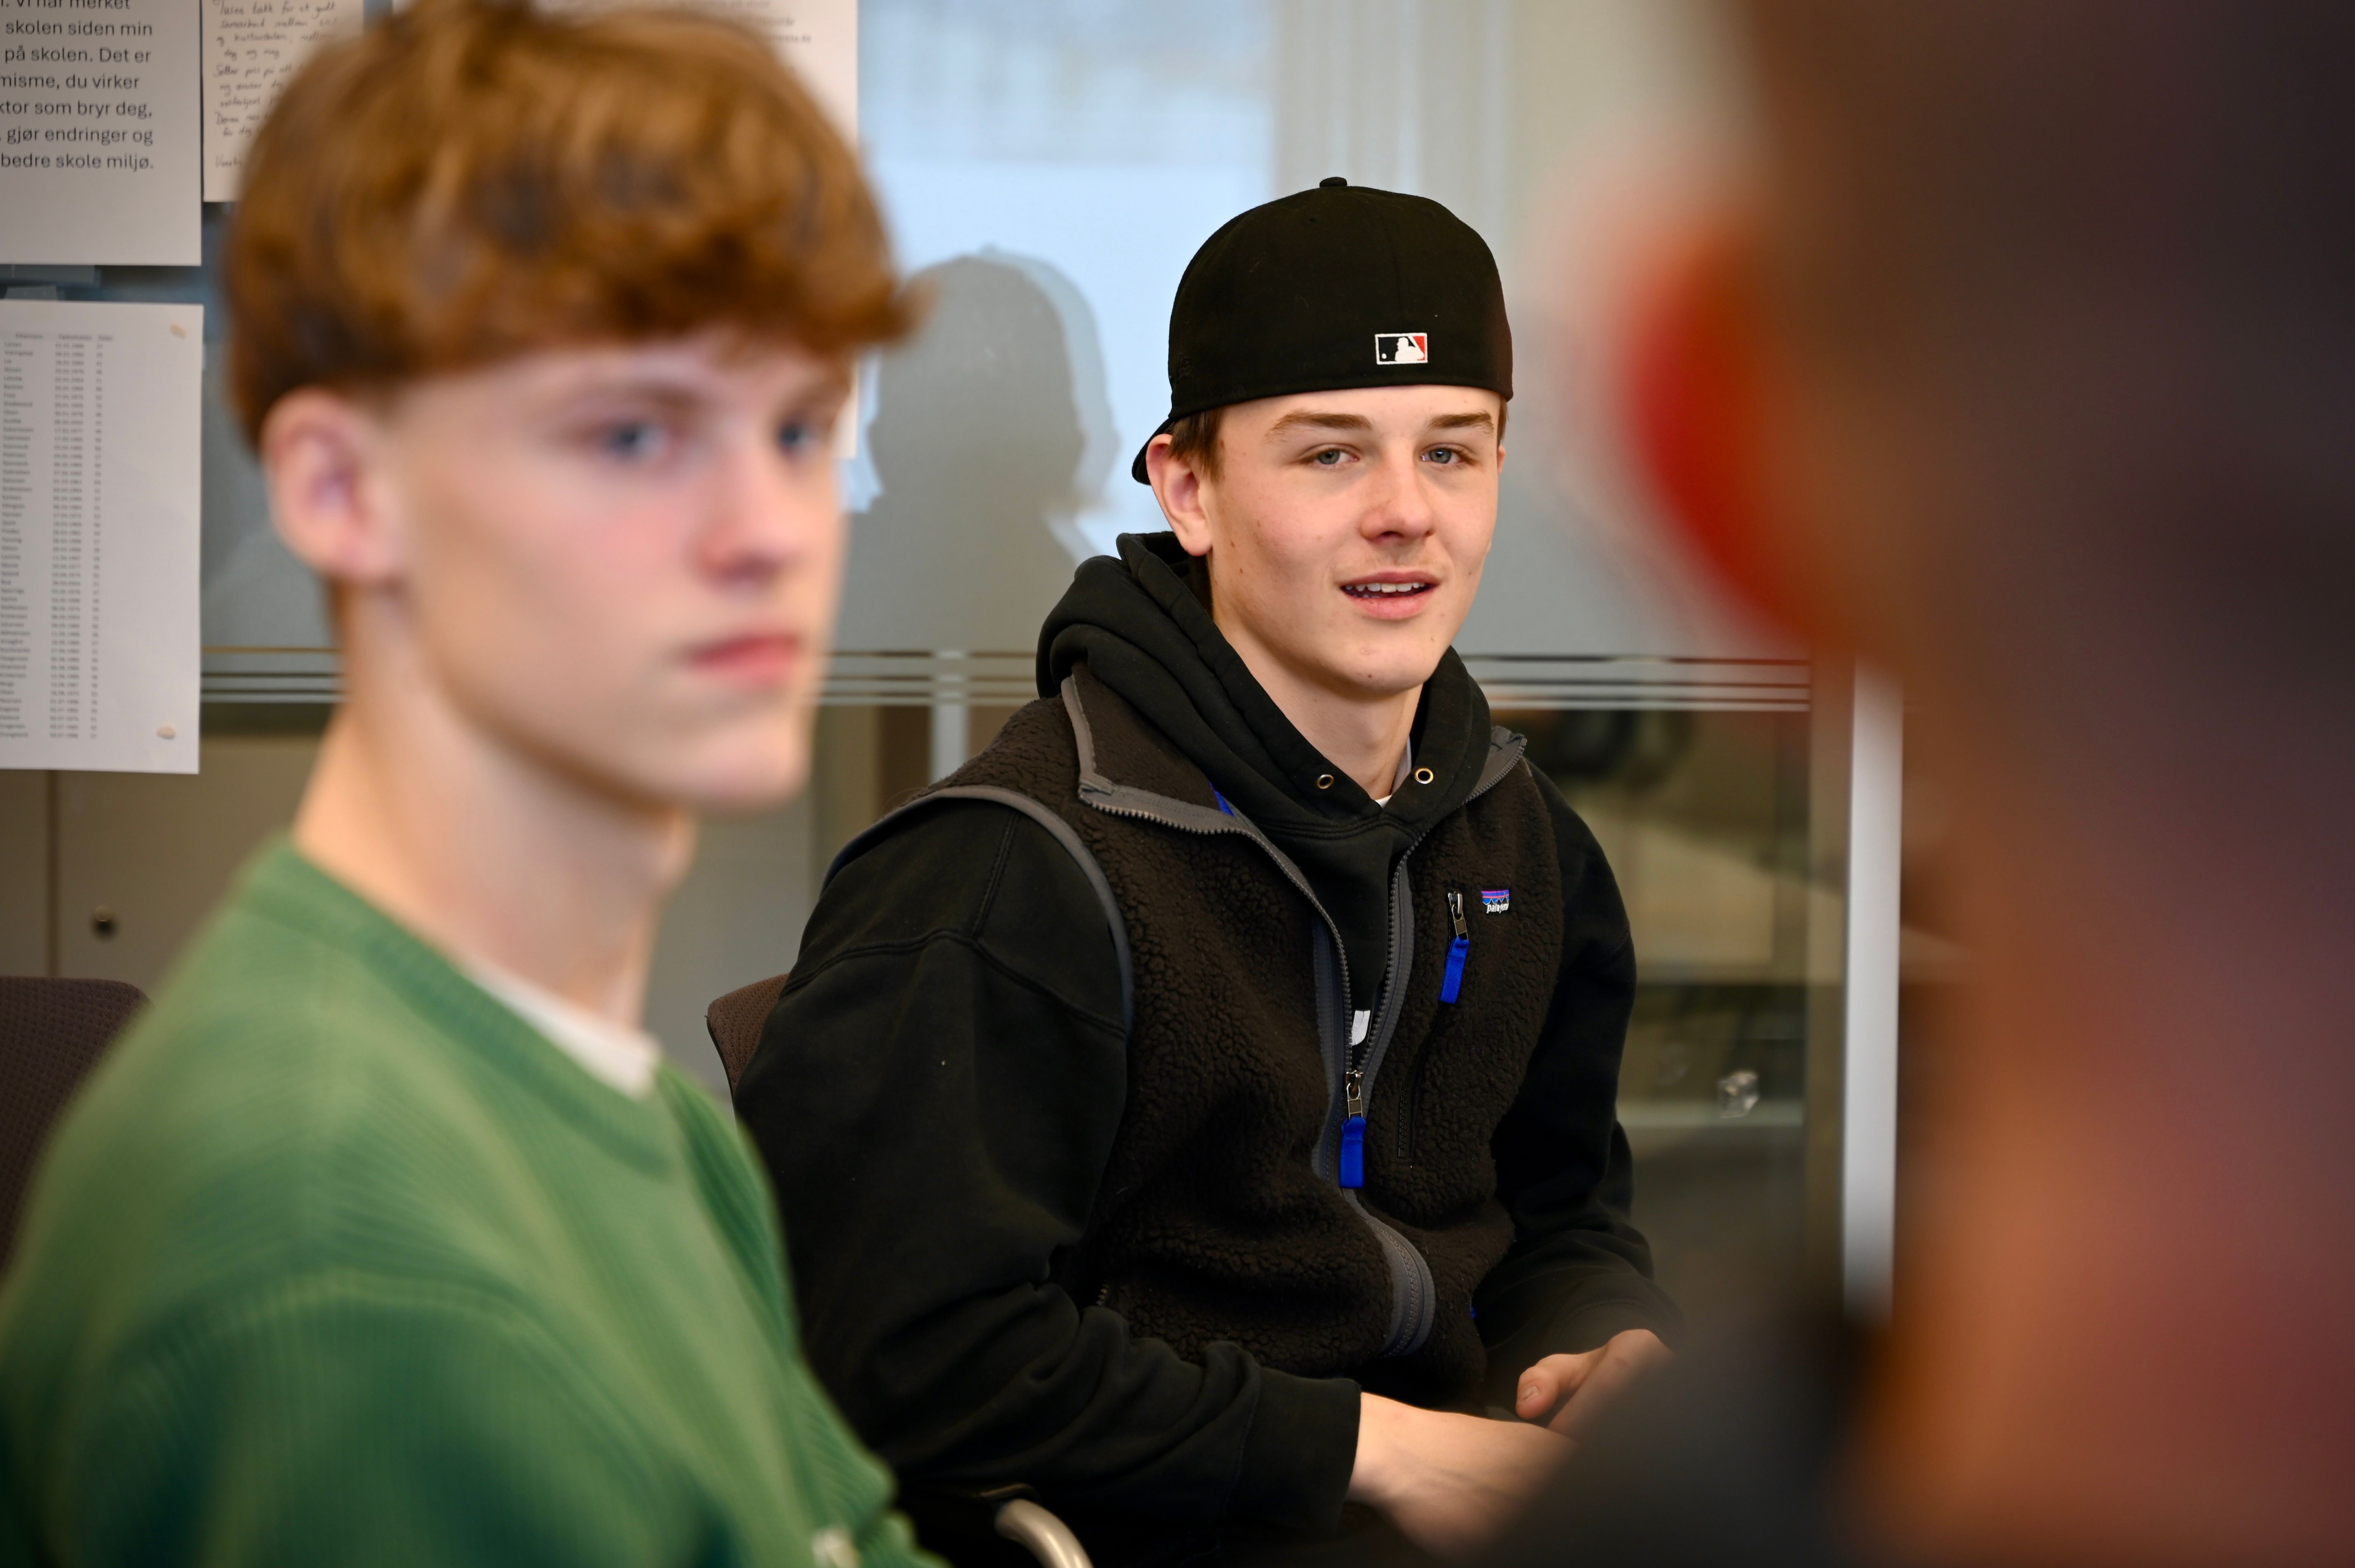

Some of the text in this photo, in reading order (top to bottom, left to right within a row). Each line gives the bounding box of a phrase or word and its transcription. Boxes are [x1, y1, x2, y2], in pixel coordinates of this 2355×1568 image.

[69, 0, 130, 10] merket
[6, 19, 153, 36] skolen siden min
[5, 45, 152, 64] på skolen. Det er
[65, 74, 87, 89] du
[92, 74, 140, 90] virker
[34, 102, 72, 115] som
[77, 100, 111, 119] bryr
[116, 100, 153, 119] deg,
[7, 125, 153, 146] gjør endringer og
[1, 152, 154, 172] bedre skole miljø.
